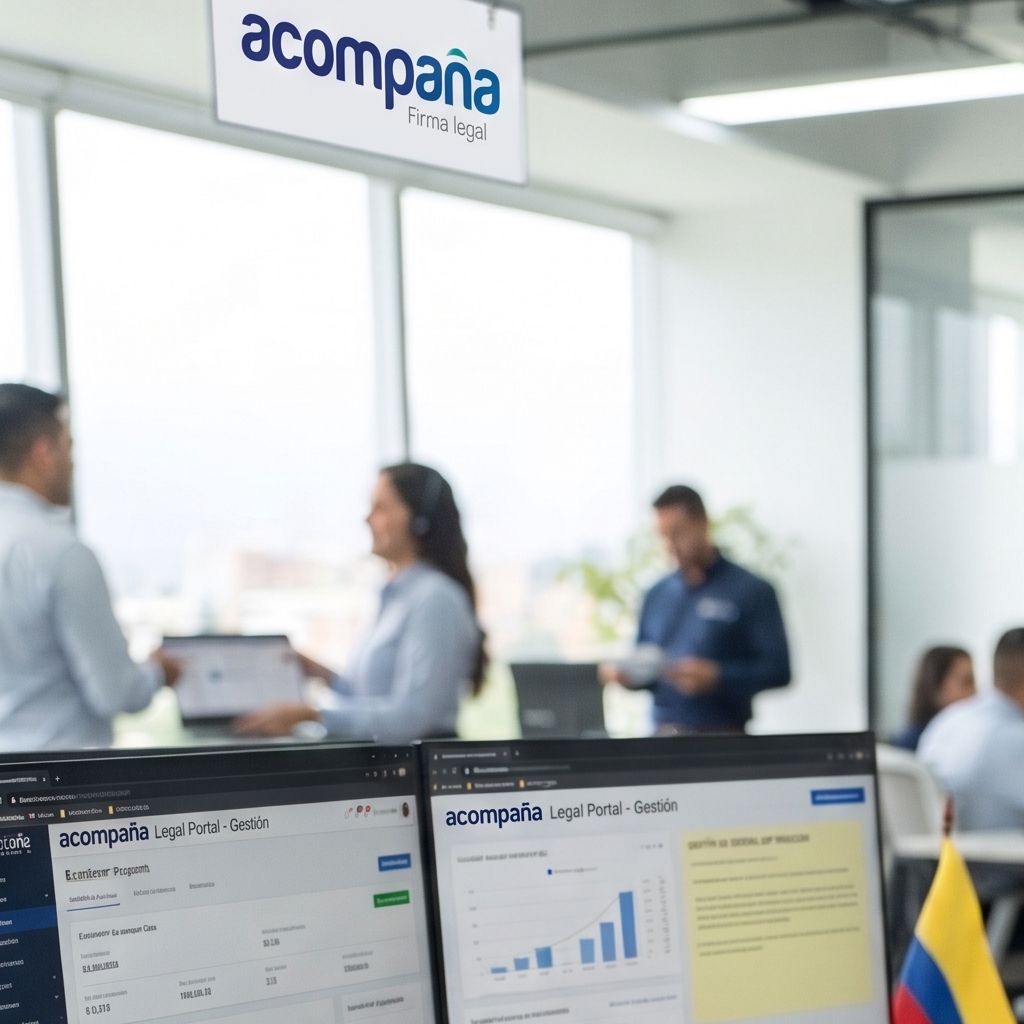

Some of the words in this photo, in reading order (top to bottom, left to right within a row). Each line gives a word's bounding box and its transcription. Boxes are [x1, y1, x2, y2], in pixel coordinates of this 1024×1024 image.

[241, 13, 501, 115] acompaña
[408, 106, 449, 133] Firma
[453, 116, 487, 142] legal
[445, 802, 543, 828] acompaña
[550, 804, 583, 822] Legal
[587, 801, 623, 817] Portal
[634, 798, 678, 814] Gestión
[59, 822, 150, 848] acompaña
[154, 822, 185, 841] Legal
[188, 819, 220, 835] Portal
[229, 816, 269, 832] Gestión
